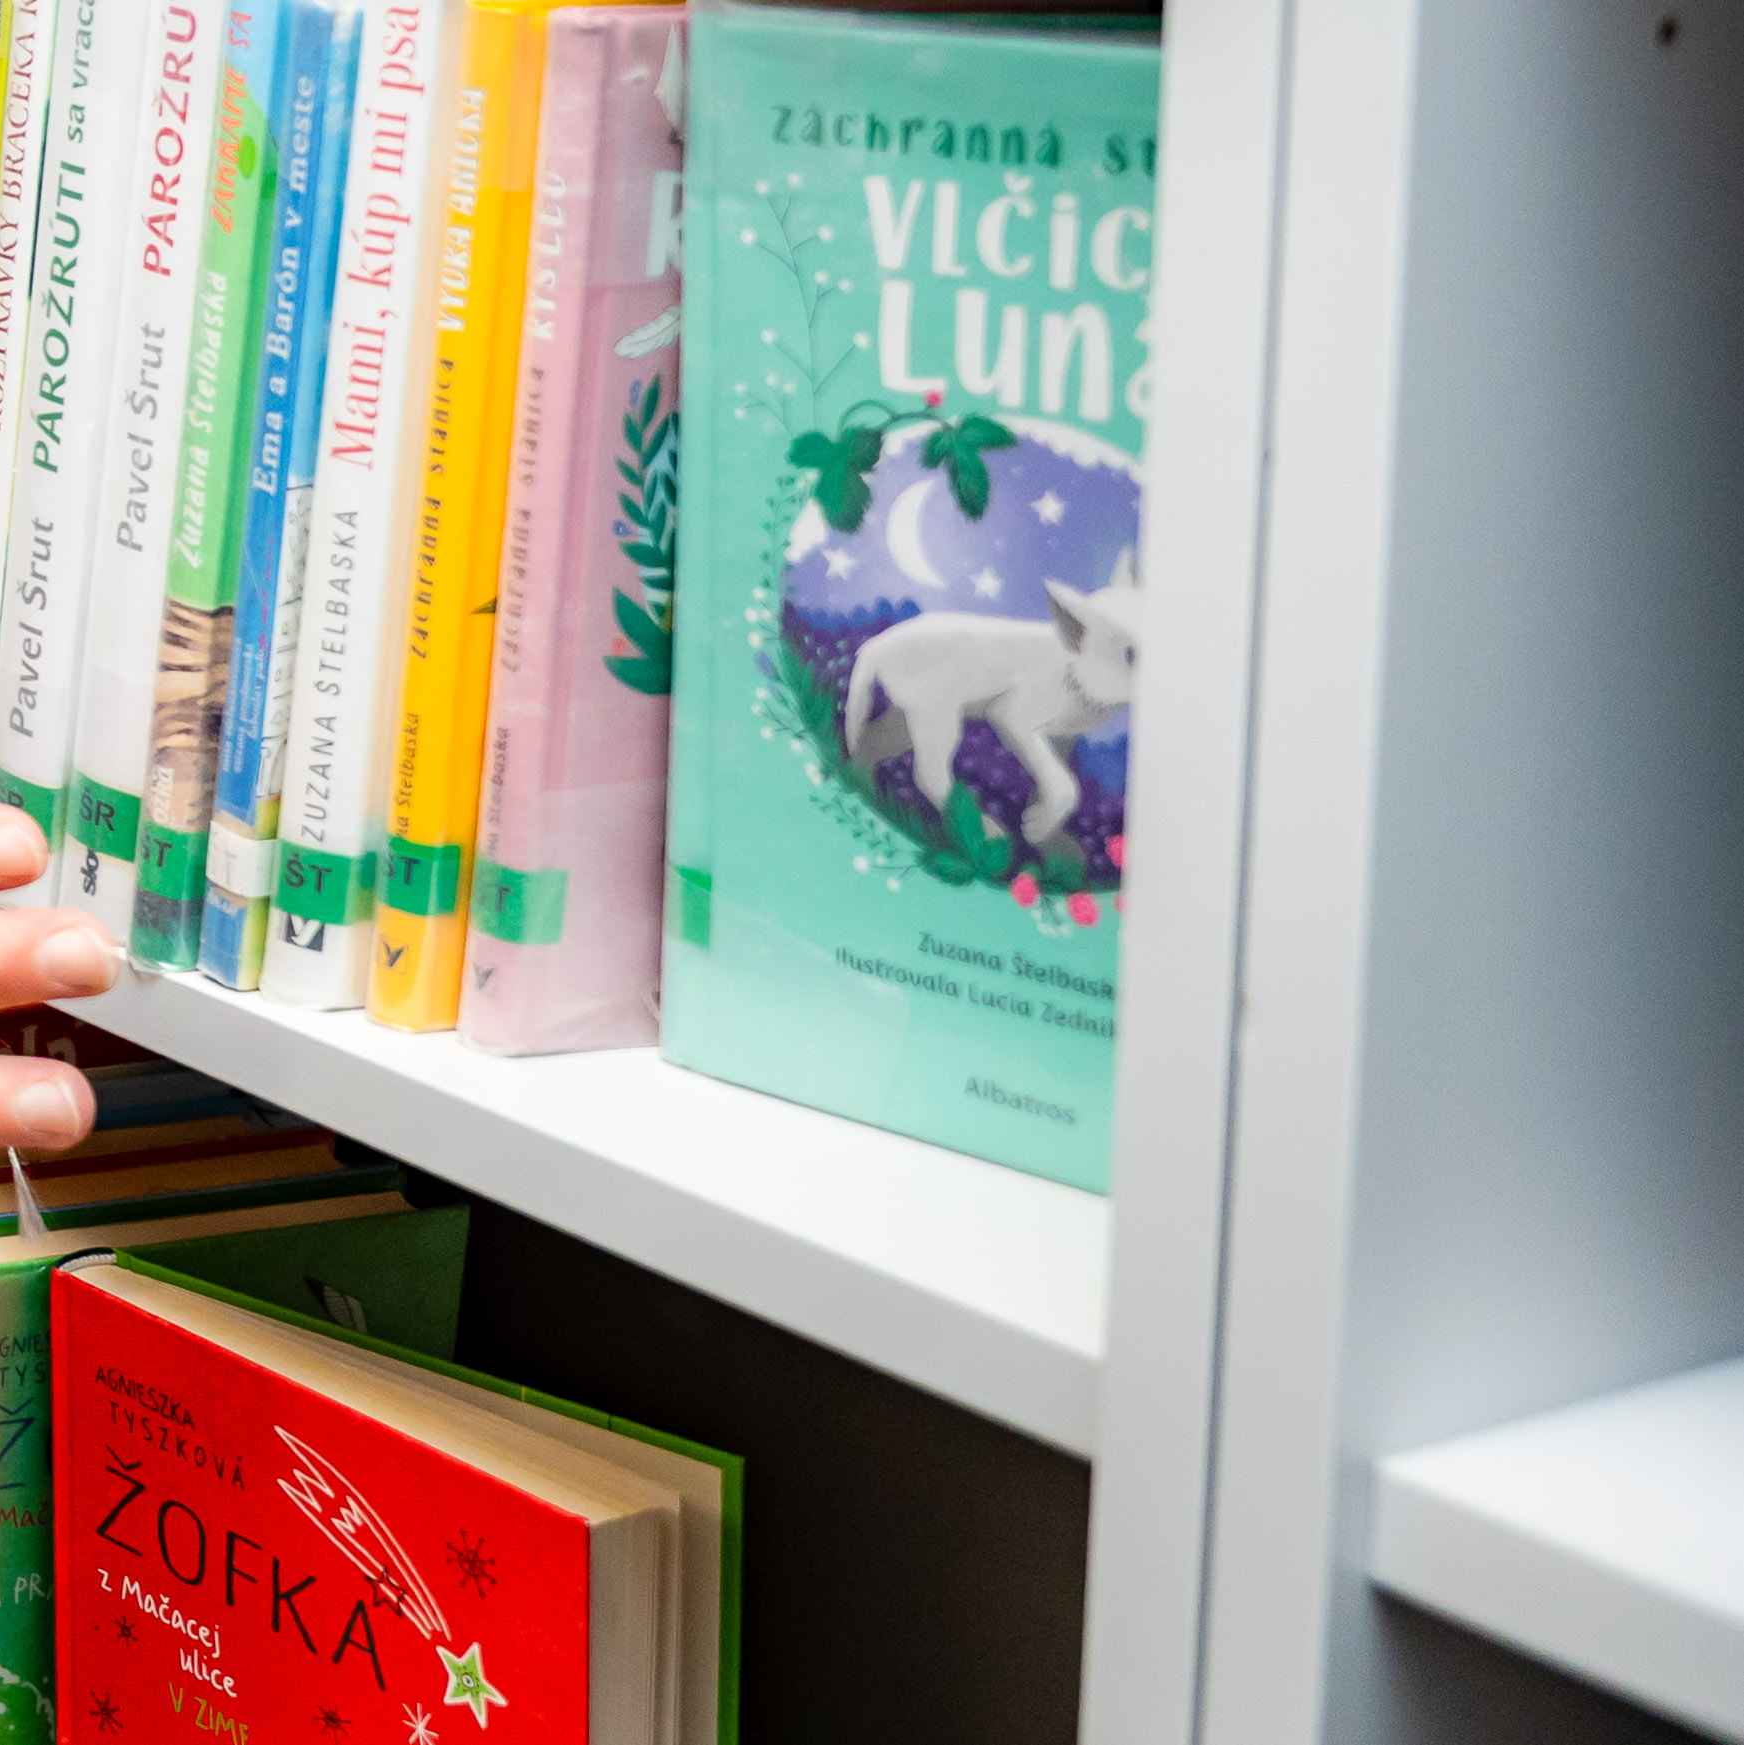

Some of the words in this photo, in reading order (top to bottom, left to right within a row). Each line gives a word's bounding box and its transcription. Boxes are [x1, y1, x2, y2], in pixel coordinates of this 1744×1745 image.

[227, 11, 254, 51] SA
[65, 102, 87, 145] sa
[288, 75, 316, 195] meste
[364, 107, 409, 178] mi
[343, 192, 412, 293] kúp
[535, 169, 567, 258] LEO
[30, 160, 87, 475] PÁROŽRÚTI
[263, 247, 300, 361] Barón
[435, 224, 474, 332] VYDRA
[529, 268, 559, 342] RYS
[123, 320, 167, 421] Šrut
[184, 268, 229, 436] Štelbaská
[327, 308, 399, 472] Mami,
[252, 410, 285, 495] Ema
[425, 357, 457, 477] stanica
[515, 364, 546, 489] stanica
[115, 431, 155, 553] Pavel
[173, 447, 211, 569] Zuzana
[17, 517, 55, 612] Šrut
[313, 509, 360, 698] ŠTELBASKÁ
[408, 494, 445, 661] Záchranná
[499, 506, 533, 675] Záchranná
[8, 620, 44, 739] Pavel
[300, 714, 340, 844] ZUZANA
[392, 711, 422, 808] Štelbaská
[77, 792, 116, 835] ŠR
[282, 852, 334, 897] ŠT
[835, 945, 960, 1000] Ilustrovala
[968, 984, 1032, 1019] Lucia
[917, 930, 1004, 974] Zuzana
[963, 1075, 1078, 1127] Albatros
[94, 1362, 196, 1432] AGNIESZKA
[107, 1399, 249, 1493] TYSZKOVÁ
[94, 1444, 390, 1692] ŽOFKA
[121, 1574, 225, 1660] Mačacej
[167, 1679, 184, 1714] V
[177, 1647, 239, 1700] ulice
